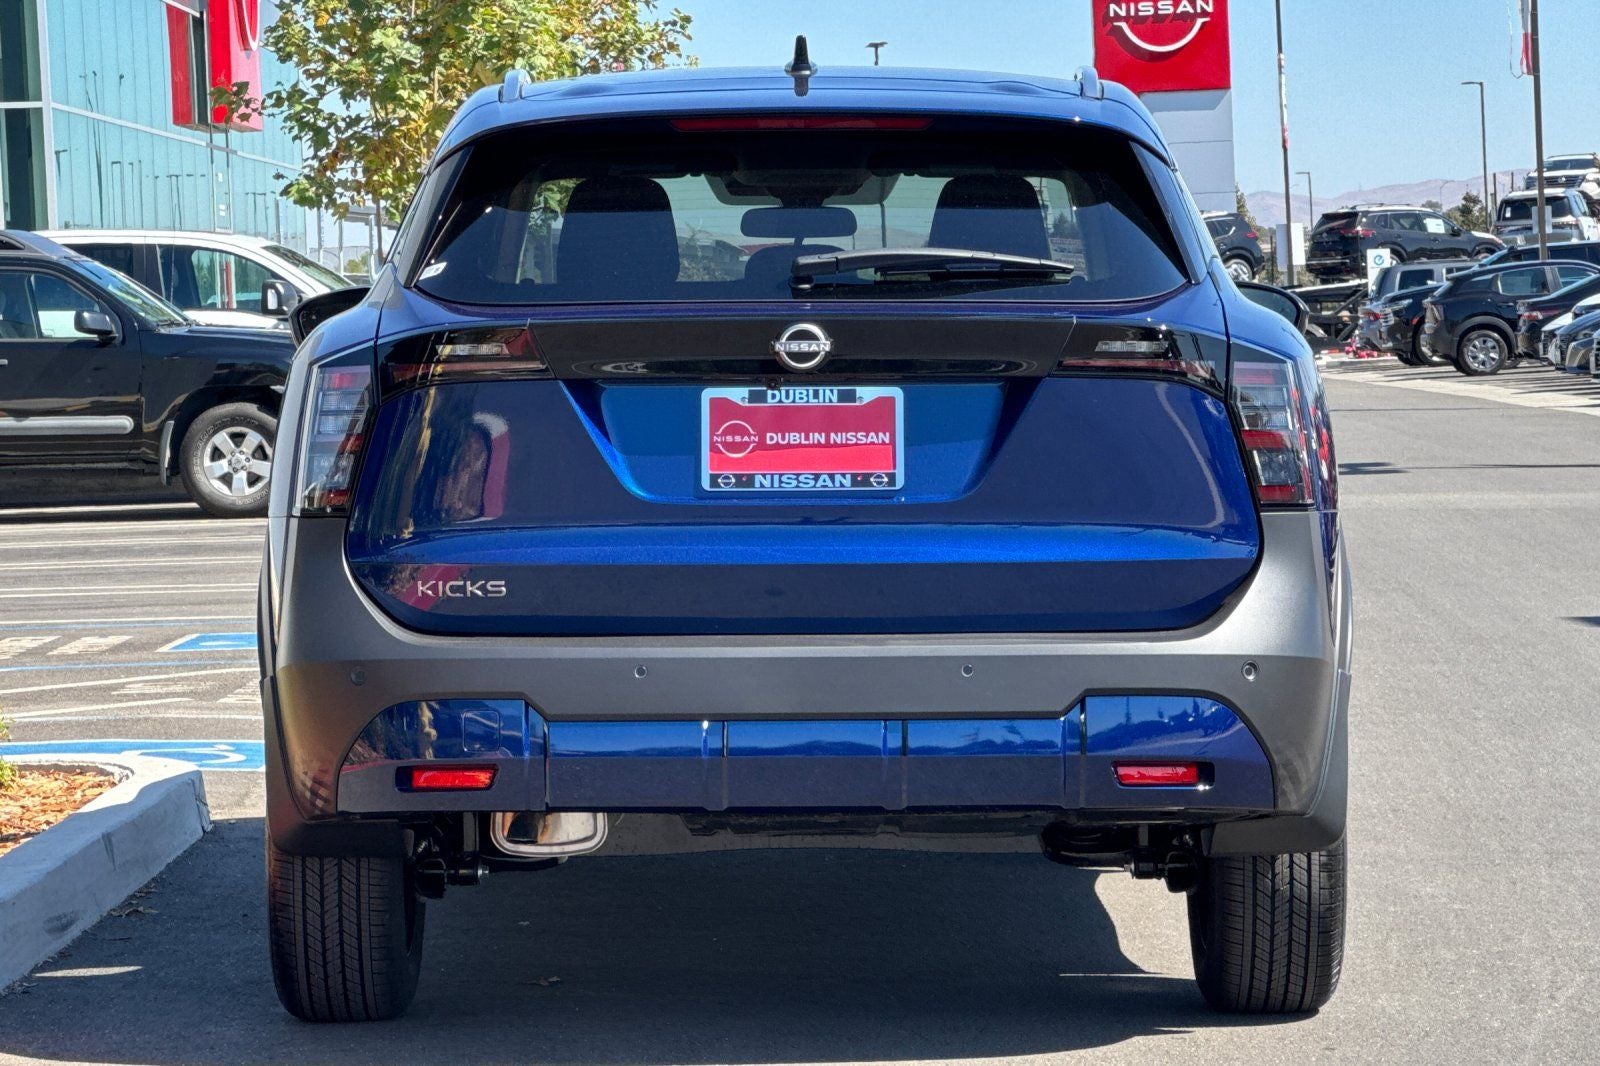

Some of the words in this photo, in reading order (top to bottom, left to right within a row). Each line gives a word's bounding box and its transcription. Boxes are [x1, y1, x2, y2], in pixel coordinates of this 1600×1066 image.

[1109, 0, 1214, 17] NISSAN
[775, 343, 830, 352] NISSAN
[767, 389, 838, 403] DUBLIN
[766, 432, 825, 445] DUBLIN
[830, 431, 890, 444] NISSAN
[754, 474, 851, 488] NISSAN
[417, 580, 507, 597] KICKS
